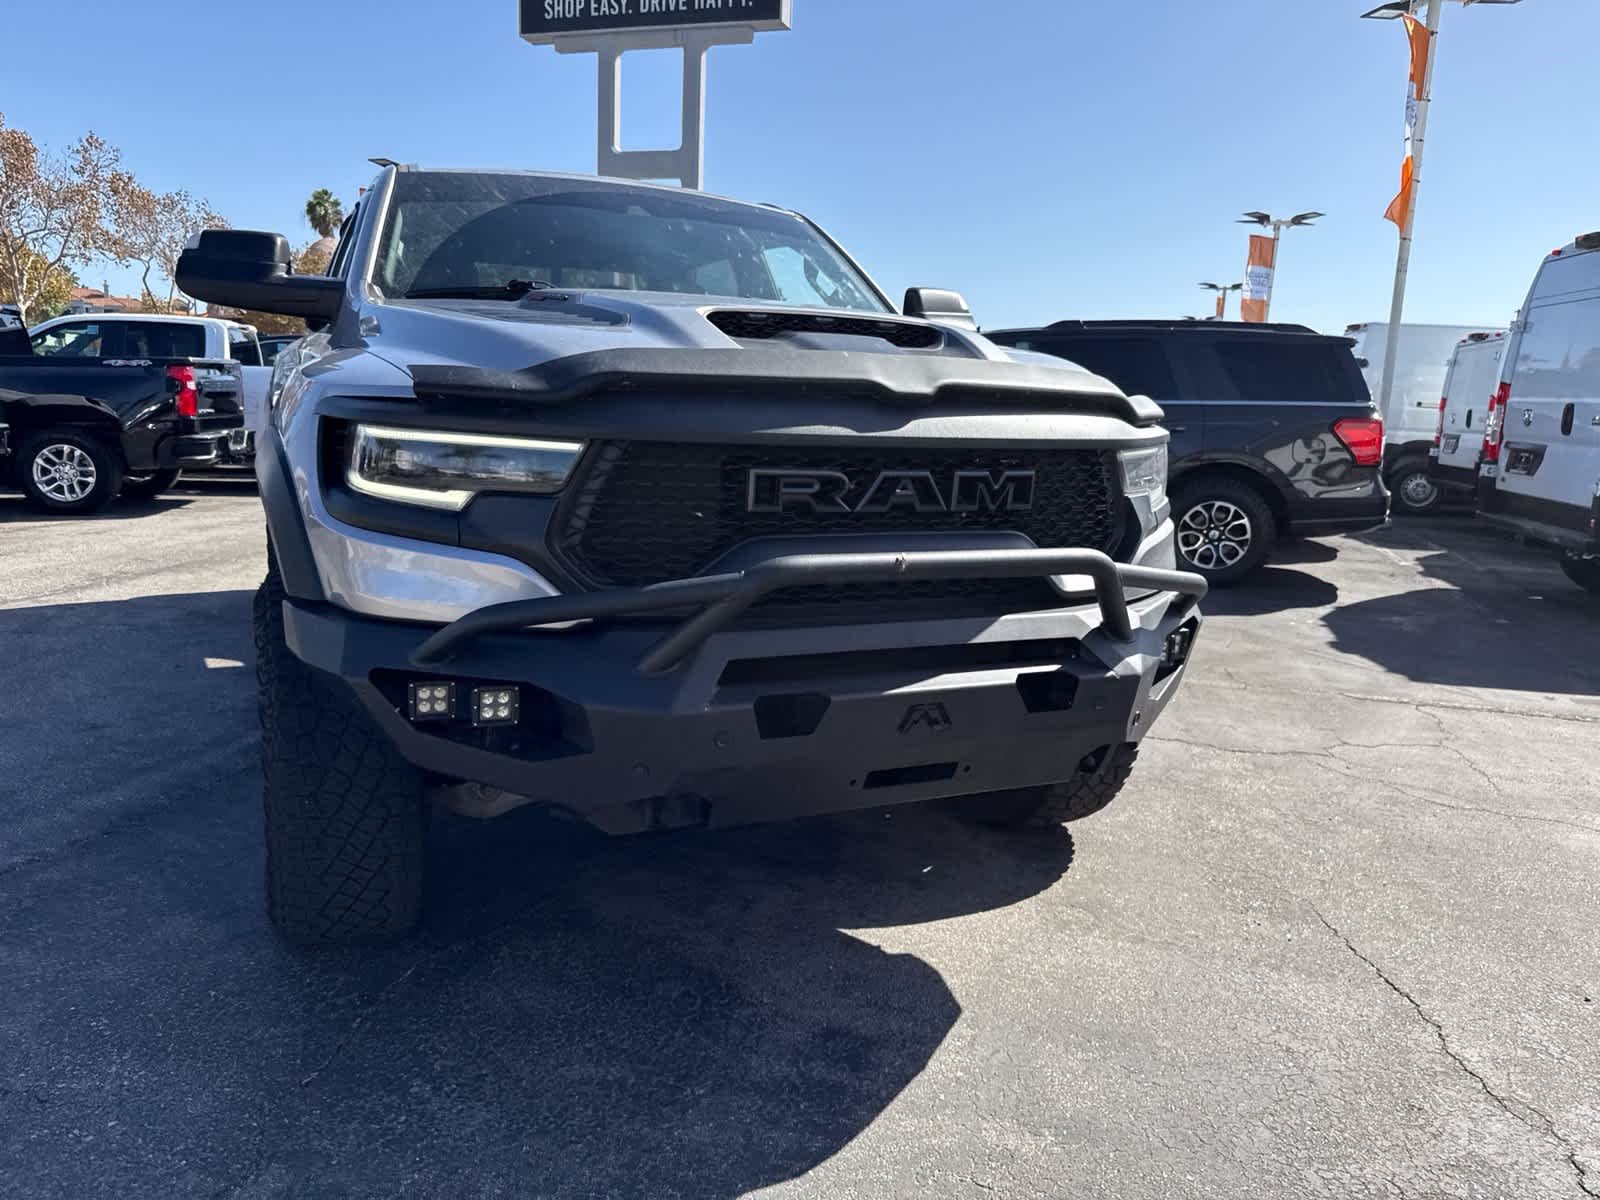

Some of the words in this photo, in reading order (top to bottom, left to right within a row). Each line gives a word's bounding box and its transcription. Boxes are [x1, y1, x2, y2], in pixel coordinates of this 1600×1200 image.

[544, 0, 585, 19] SHOP
[590, 0, 633, 17] EASY.
[748, 468, 1036, 512] RAM
